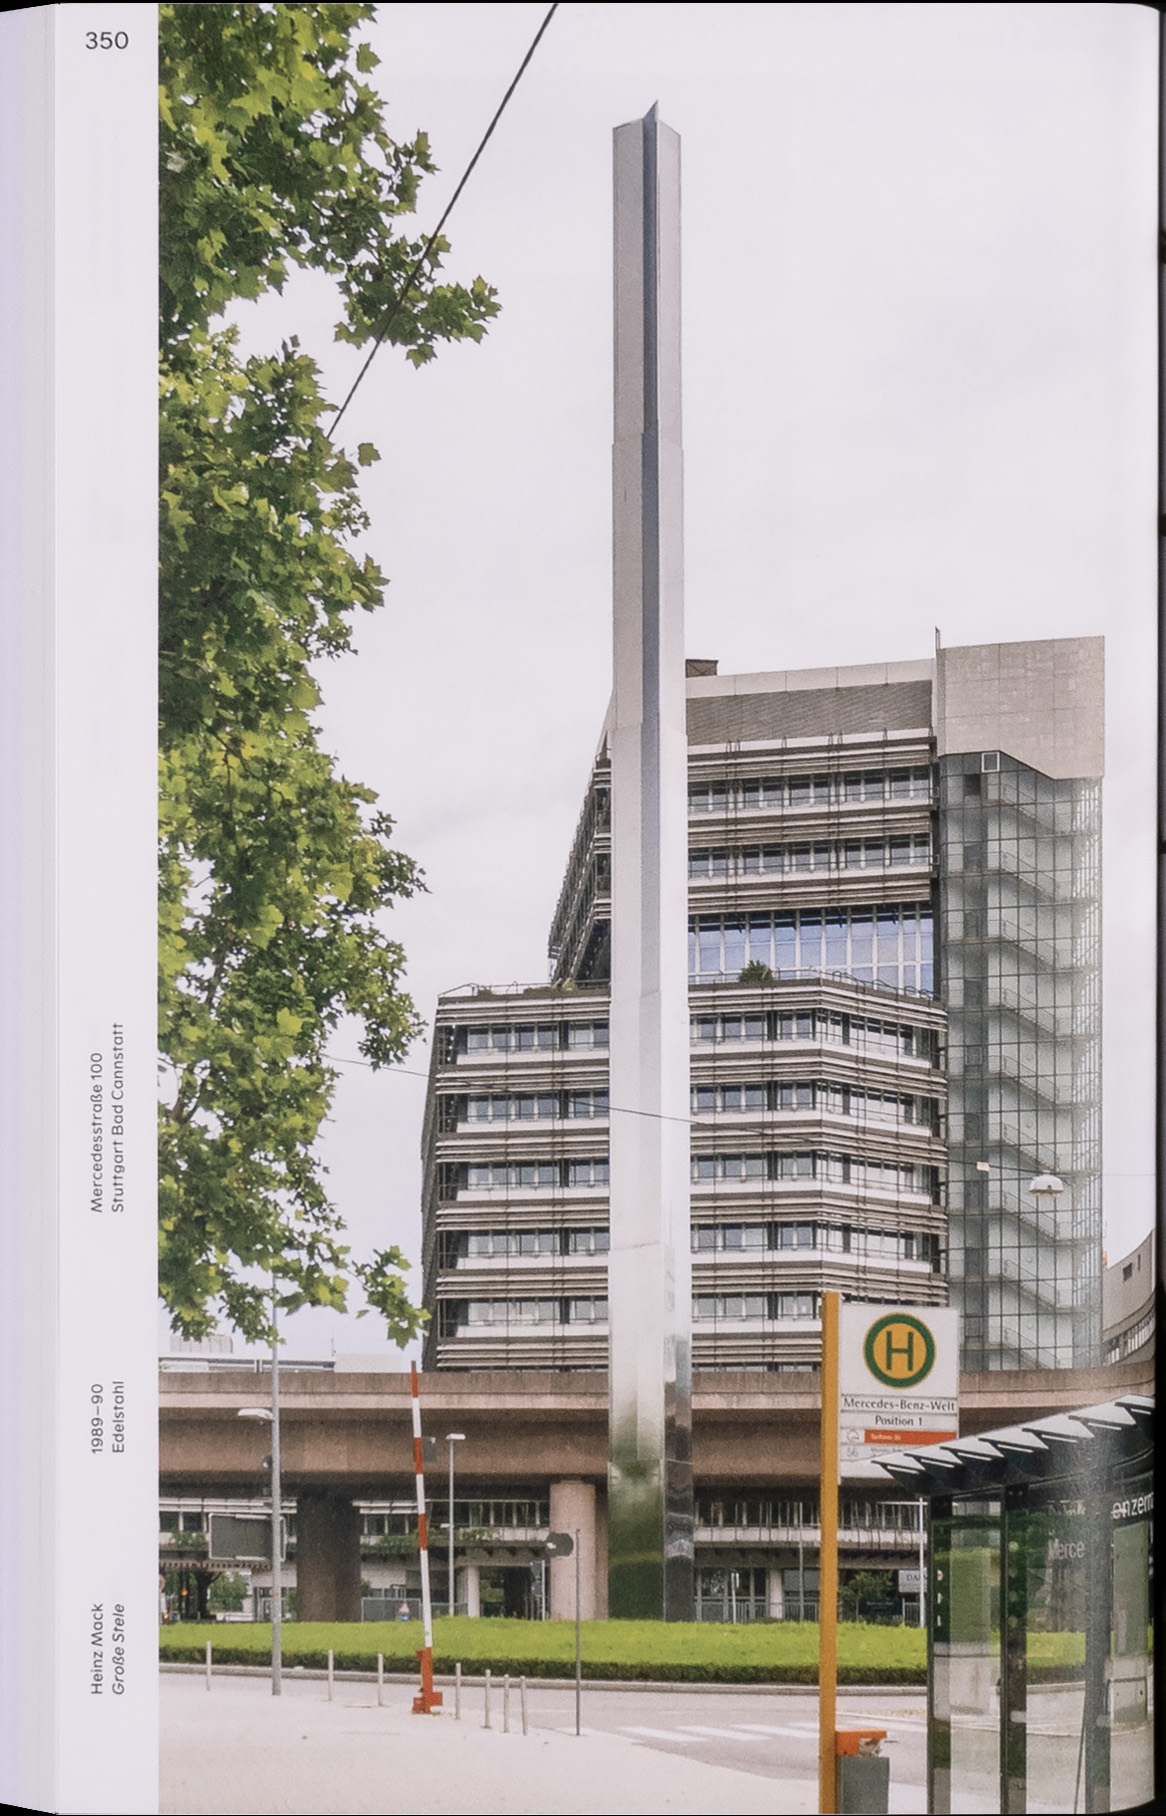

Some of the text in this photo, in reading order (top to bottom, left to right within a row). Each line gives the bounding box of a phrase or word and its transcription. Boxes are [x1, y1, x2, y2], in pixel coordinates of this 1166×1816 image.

[86, 31, 129, 50] 350
[90, 1053, 103, 1213] Mercedesstraße 100
[111, 1023, 125, 1212] Stuttgart Bad Cannstatt
[885, 1330, 914, 1371] H
[111, 1381, 124, 1453] Edelstahl
[844, 1398, 955, 1411] Mercedes-Benz-Welt
[875, 1415, 923, 1426] Position 1
[846, 1447, 859, 1457] 56
[91, 1604, 103, 1694] Heinz Mack
[112, 1604, 125, 1695] Große Stele
